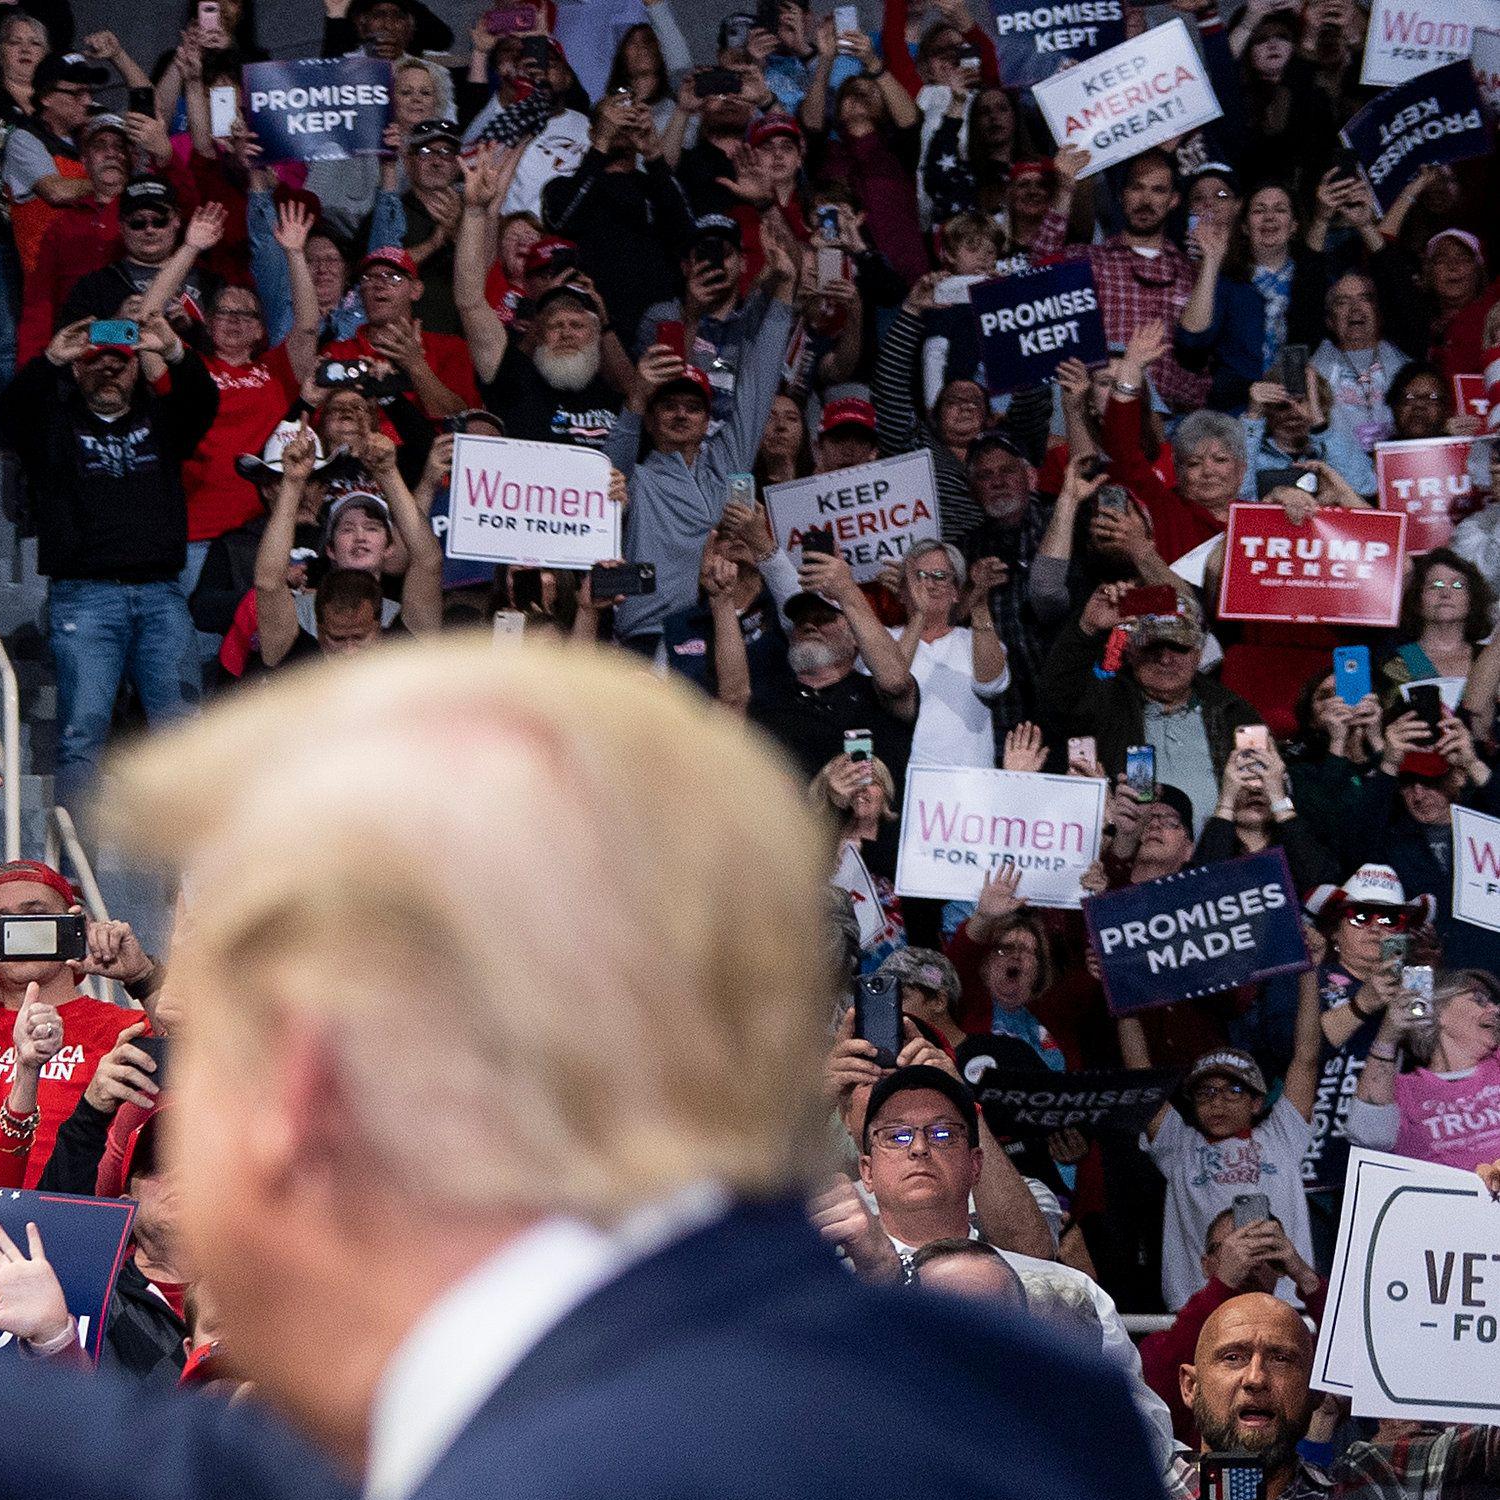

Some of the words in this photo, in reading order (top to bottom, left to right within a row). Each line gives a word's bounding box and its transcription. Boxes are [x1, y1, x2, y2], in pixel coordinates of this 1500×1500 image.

[997, 3, 1122, 36] PROMISES
[1382, 12, 1473, 46] Wom
[1034, 28, 1098, 53] KEPT
[1082, 56, 1148, 94] KEEP
[252, 86, 389, 114] PROMISES
[1064, 66, 1195, 138] AMERICA
[288, 111, 357, 135] KEPT
[1091, 97, 1187, 149] GREAT!
[1379, 97, 1441, 143] KEPT
[980, 289, 1097, 337] PROMISES
[1019, 322, 1080, 357] KEPT
[466, 467, 606, 520] Women
[816, 479, 890, 515] KEEP
[1392, 477, 1472, 498] TRU
[477, 515, 516, 531] FOR
[526, 520, 591, 537] TRUMP
[843, 533, 914, 567] REAT!
[1240, 536, 1390, 559] TRUMP
[1252, 560, 1373, 579] PENCE
[919, 801, 1084, 853] Women
[933, 848, 979, 866] FOR
[1100, 883, 1286, 956] PROMISES
[1147, 924, 1256, 975] MADE
[1012, 1105, 1110, 1128] KEPT
[1300, 1052, 1345, 1183] PROMIS
